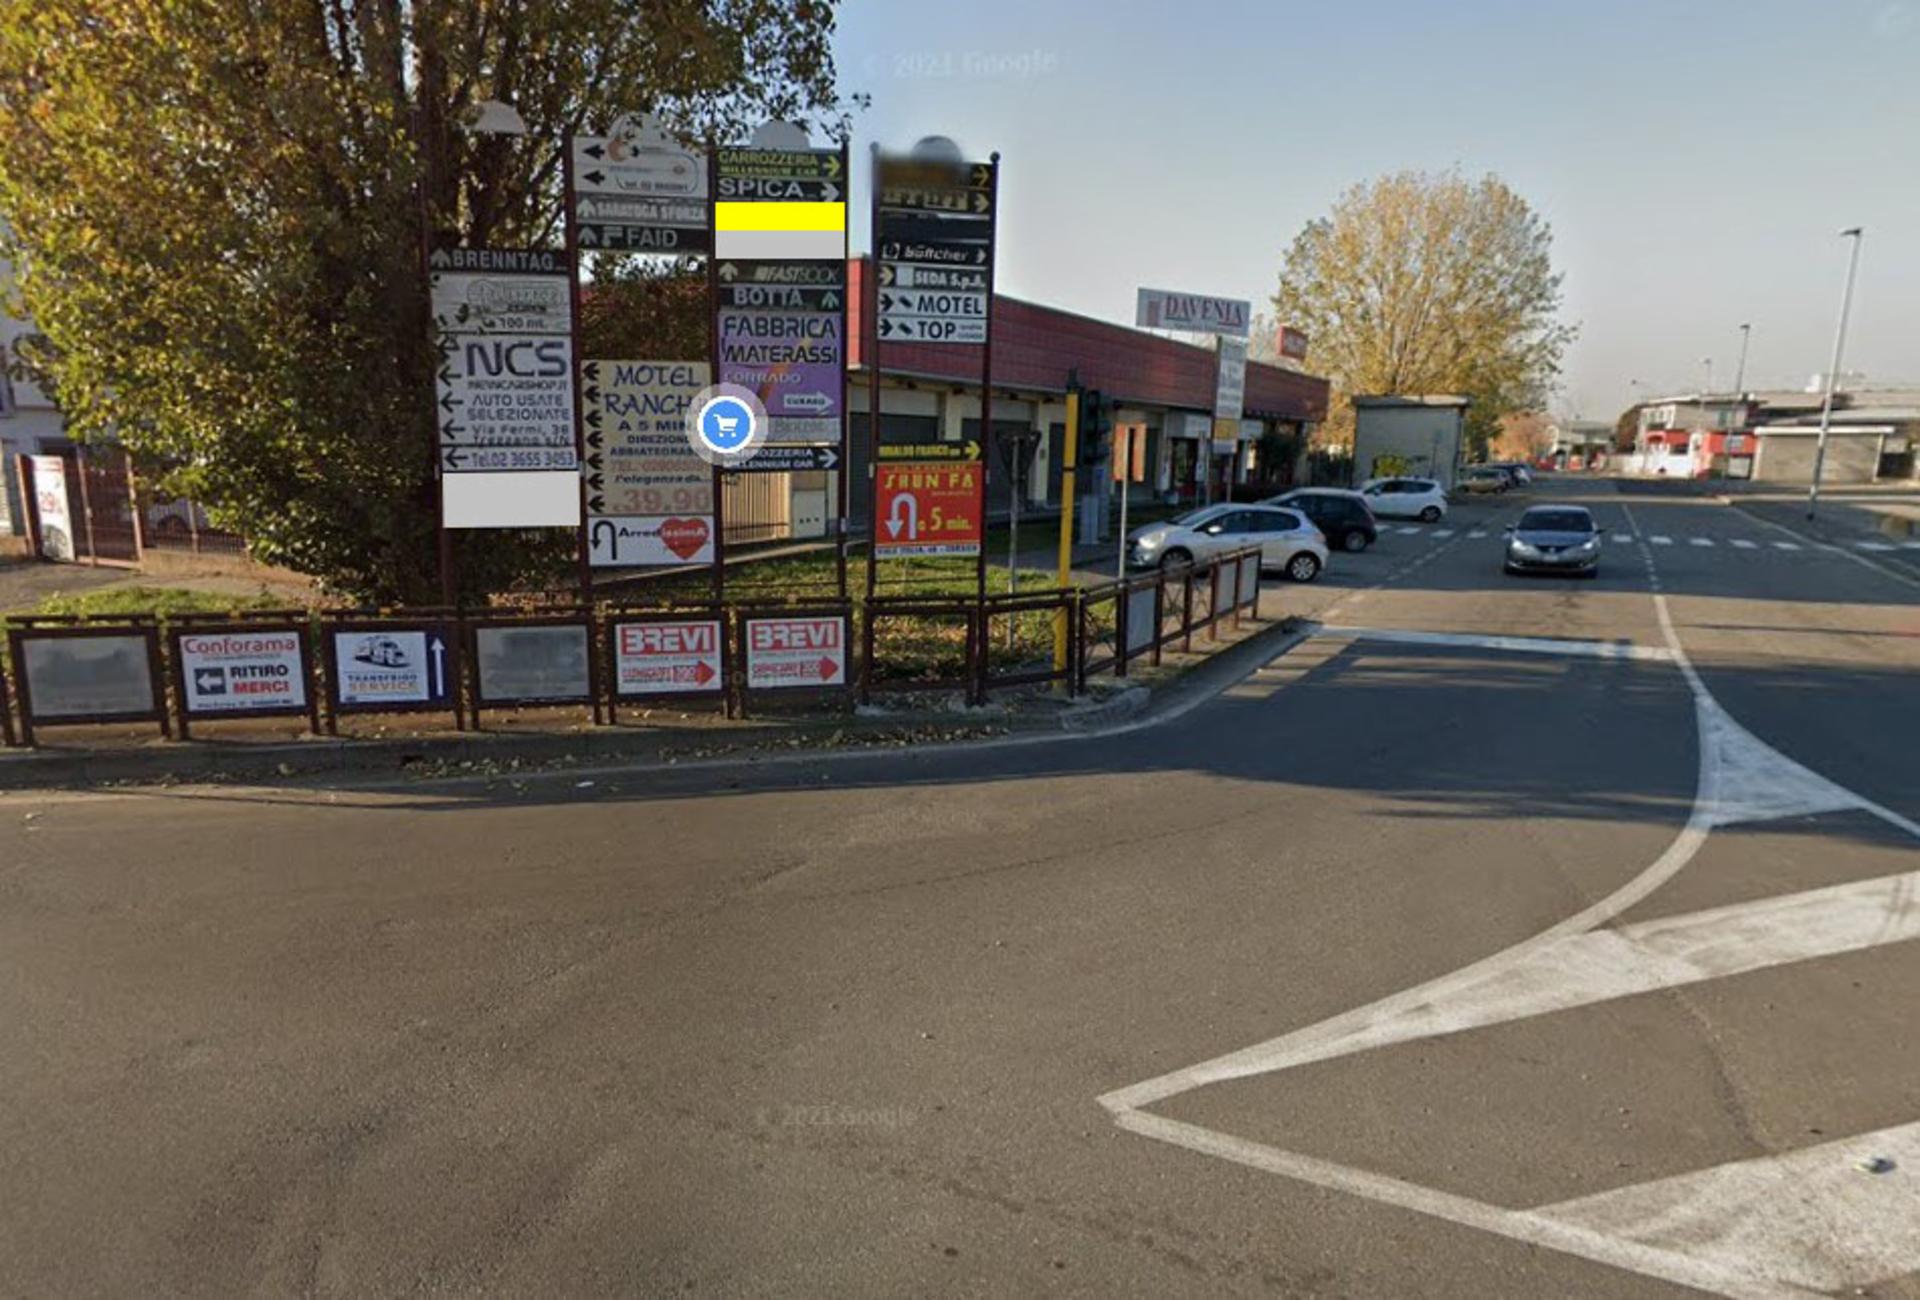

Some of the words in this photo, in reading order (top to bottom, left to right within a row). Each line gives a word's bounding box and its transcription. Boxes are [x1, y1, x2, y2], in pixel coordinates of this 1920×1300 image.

[718, 178, 804, 197] SPICA
[627, 229, 678, 247] FAID
[452, 250, 553, 271] BRENNTAG
[914, 270, 947, 287] SEDA
[734, 287, 803, 305] BOTTA
[917, 295, 983, 315] MOTEL
[724, 316, 836, 338] FABBRICA
[917, 321, 956, 340] TOP
[466, 340, 568, 377] NCS
[724, 345, 838, 363] MATERASSI
[613, 364, 700, 387] MOTEL
[472, 394, 513, 406] AUTO
[517, 394, 564, 407] USATE
[604, 393, 693, 416] RANCH
[467, 408, 570, 421] SELEZIONATE
[472, 424, 495, 435] Via
[618, 421, 631, 432] A
[884, 473, 939, 489] SHUN
[949, 473, 974, 489] FA
[930, 507, 942, 531] 5
[625, 627, 711, 652] BREVI
[755, 623, 836, 648] BREVI
[184, 637, 296, 654] Conforama
[230, 664, 289, 678] RITIRO
[233, 681, 290, 694] MERCI
